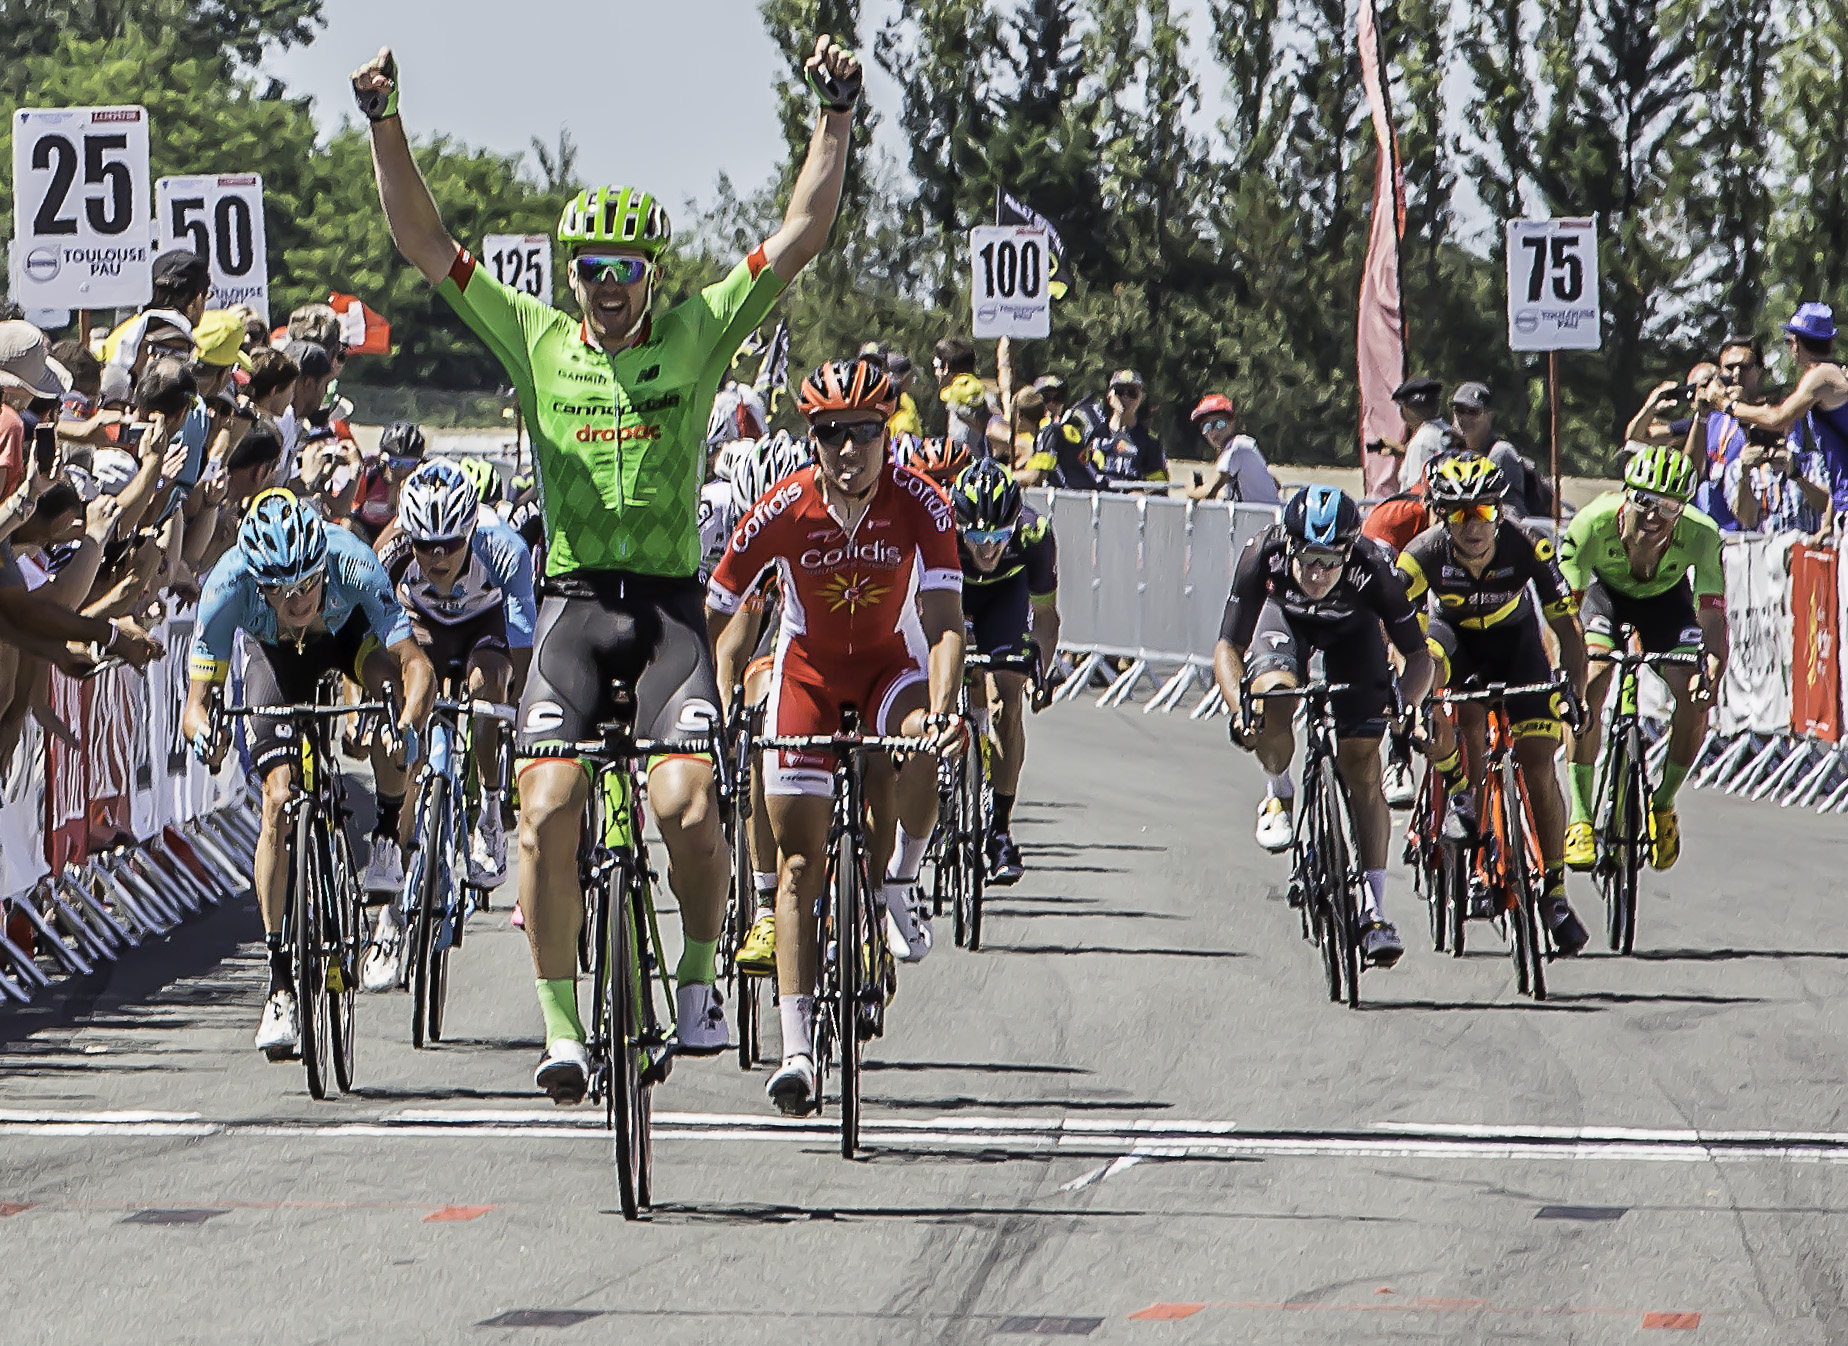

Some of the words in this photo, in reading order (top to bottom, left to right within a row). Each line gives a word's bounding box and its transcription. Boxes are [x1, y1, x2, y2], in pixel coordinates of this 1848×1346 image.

[32, 133, 132, 236] 25
[63, 247, 147, 263] TOULOUSE
[171, 195, 253, 277] 50
[90, 260, 121, 276] PAU
[491, 247, 543, 297] 125
[980, 240, 1040, 299] 100
[1522, 236, 1583, 303] 75
